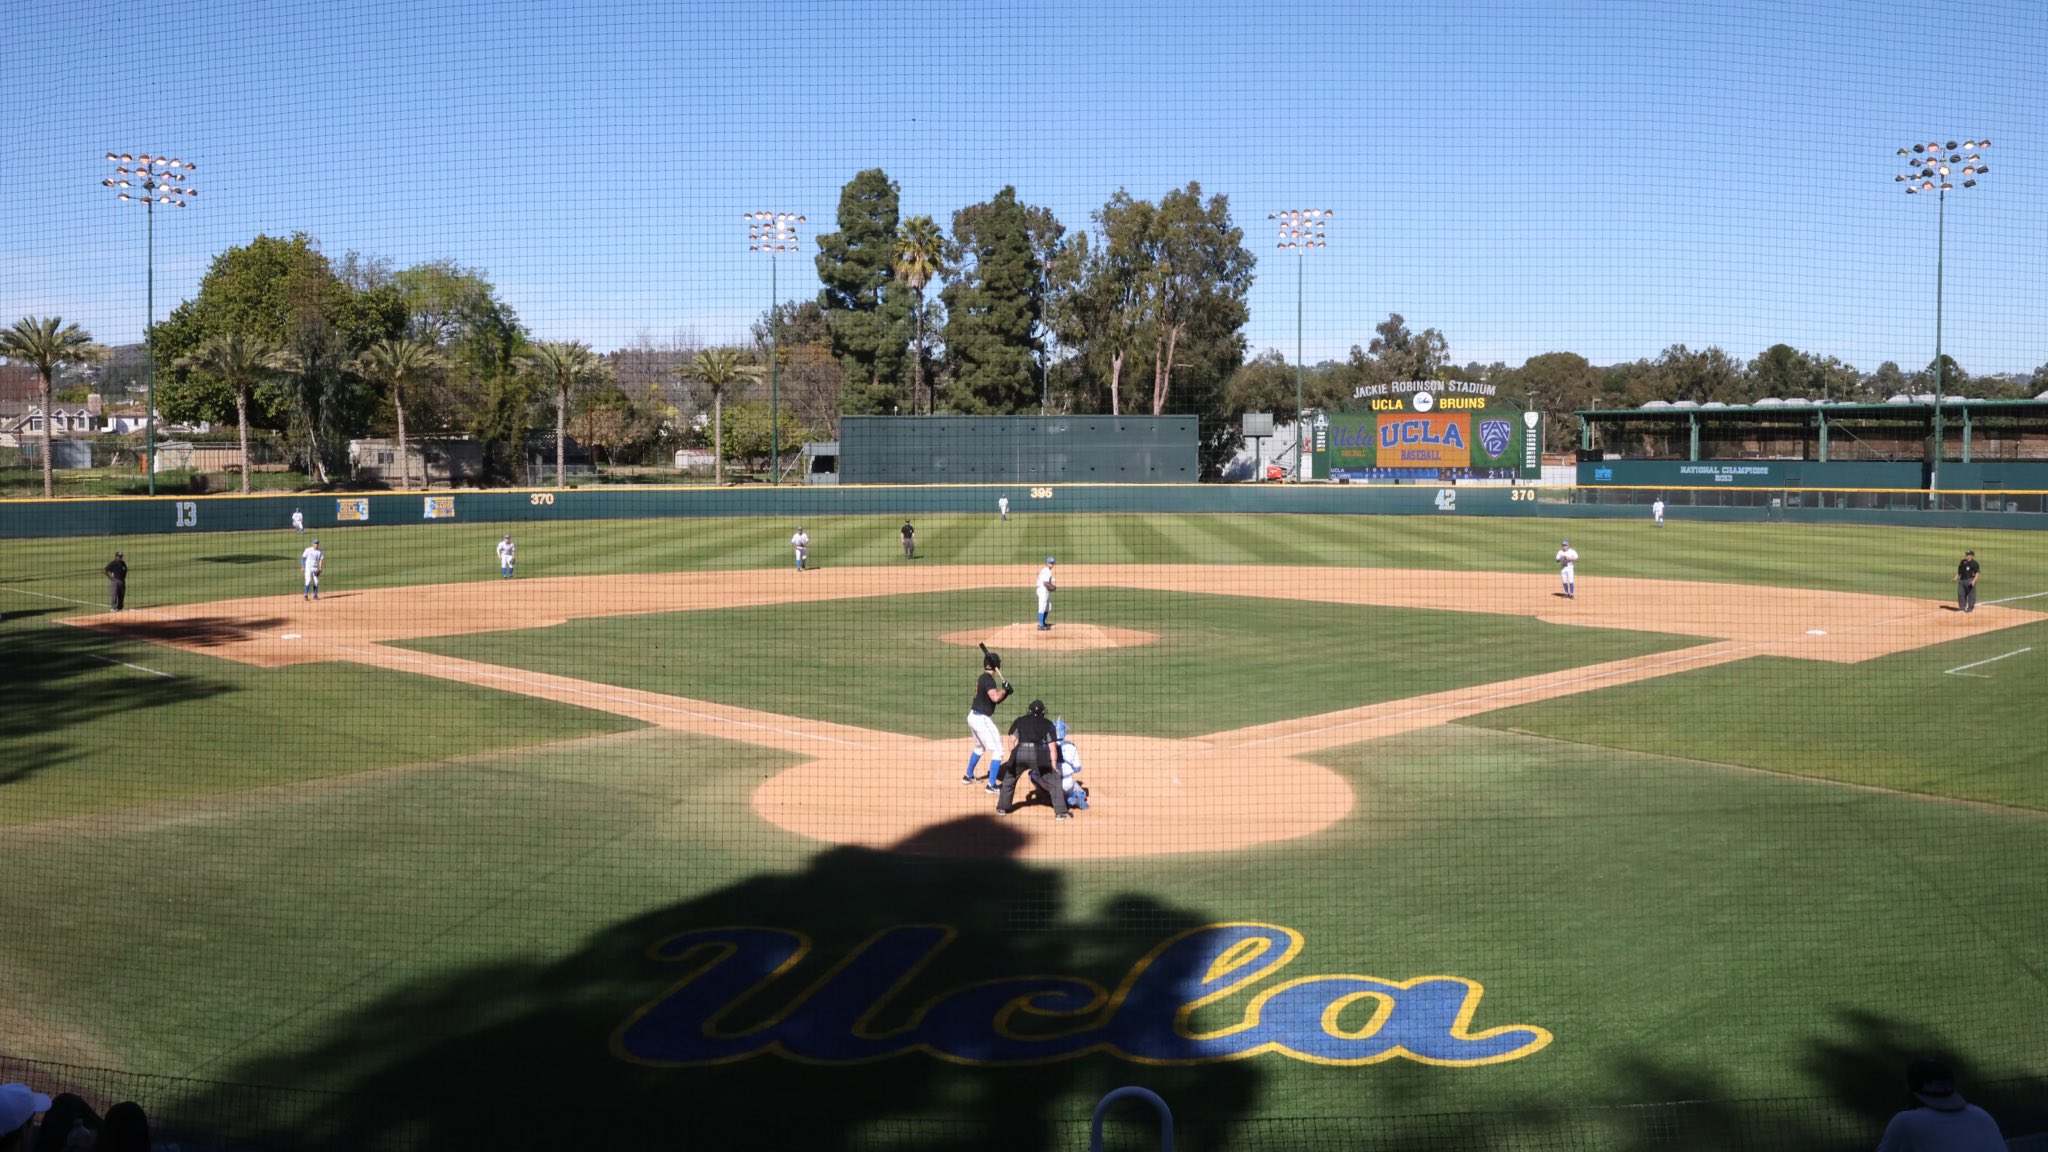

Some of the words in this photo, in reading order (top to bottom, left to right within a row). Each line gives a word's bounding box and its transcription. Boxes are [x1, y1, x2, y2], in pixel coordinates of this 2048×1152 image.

[1353, 383, 1388, 399] JACKIE
[1391, 381, 1444, 393] ROBINSON
[1448, 380, 1496, 396] STADIUM
[1372, 399, 1403, 410] UCLA
[1440, 398, 1485, 409] BRUINS
[1380, 419, 1465, 449] UCLA
[1488, 440, 1502, 452] 12
[1401, 449, 1442, 461] BASEBALL
[1488, 470, 1495, 479] 2
[1680, 466, 1719, 474] NATIONAL
[1722, 466, 1768, 474] CHAMPIONS
[1030, 487, 1053, 498] 395
[1511, 489, 1535, 501] 370
[530, 493, 554, 505] 370
[1435, 489, 1456, 511] 42
[176, 501, 197, 527] 13
[609, 921, 1553, 1068] Ucla
